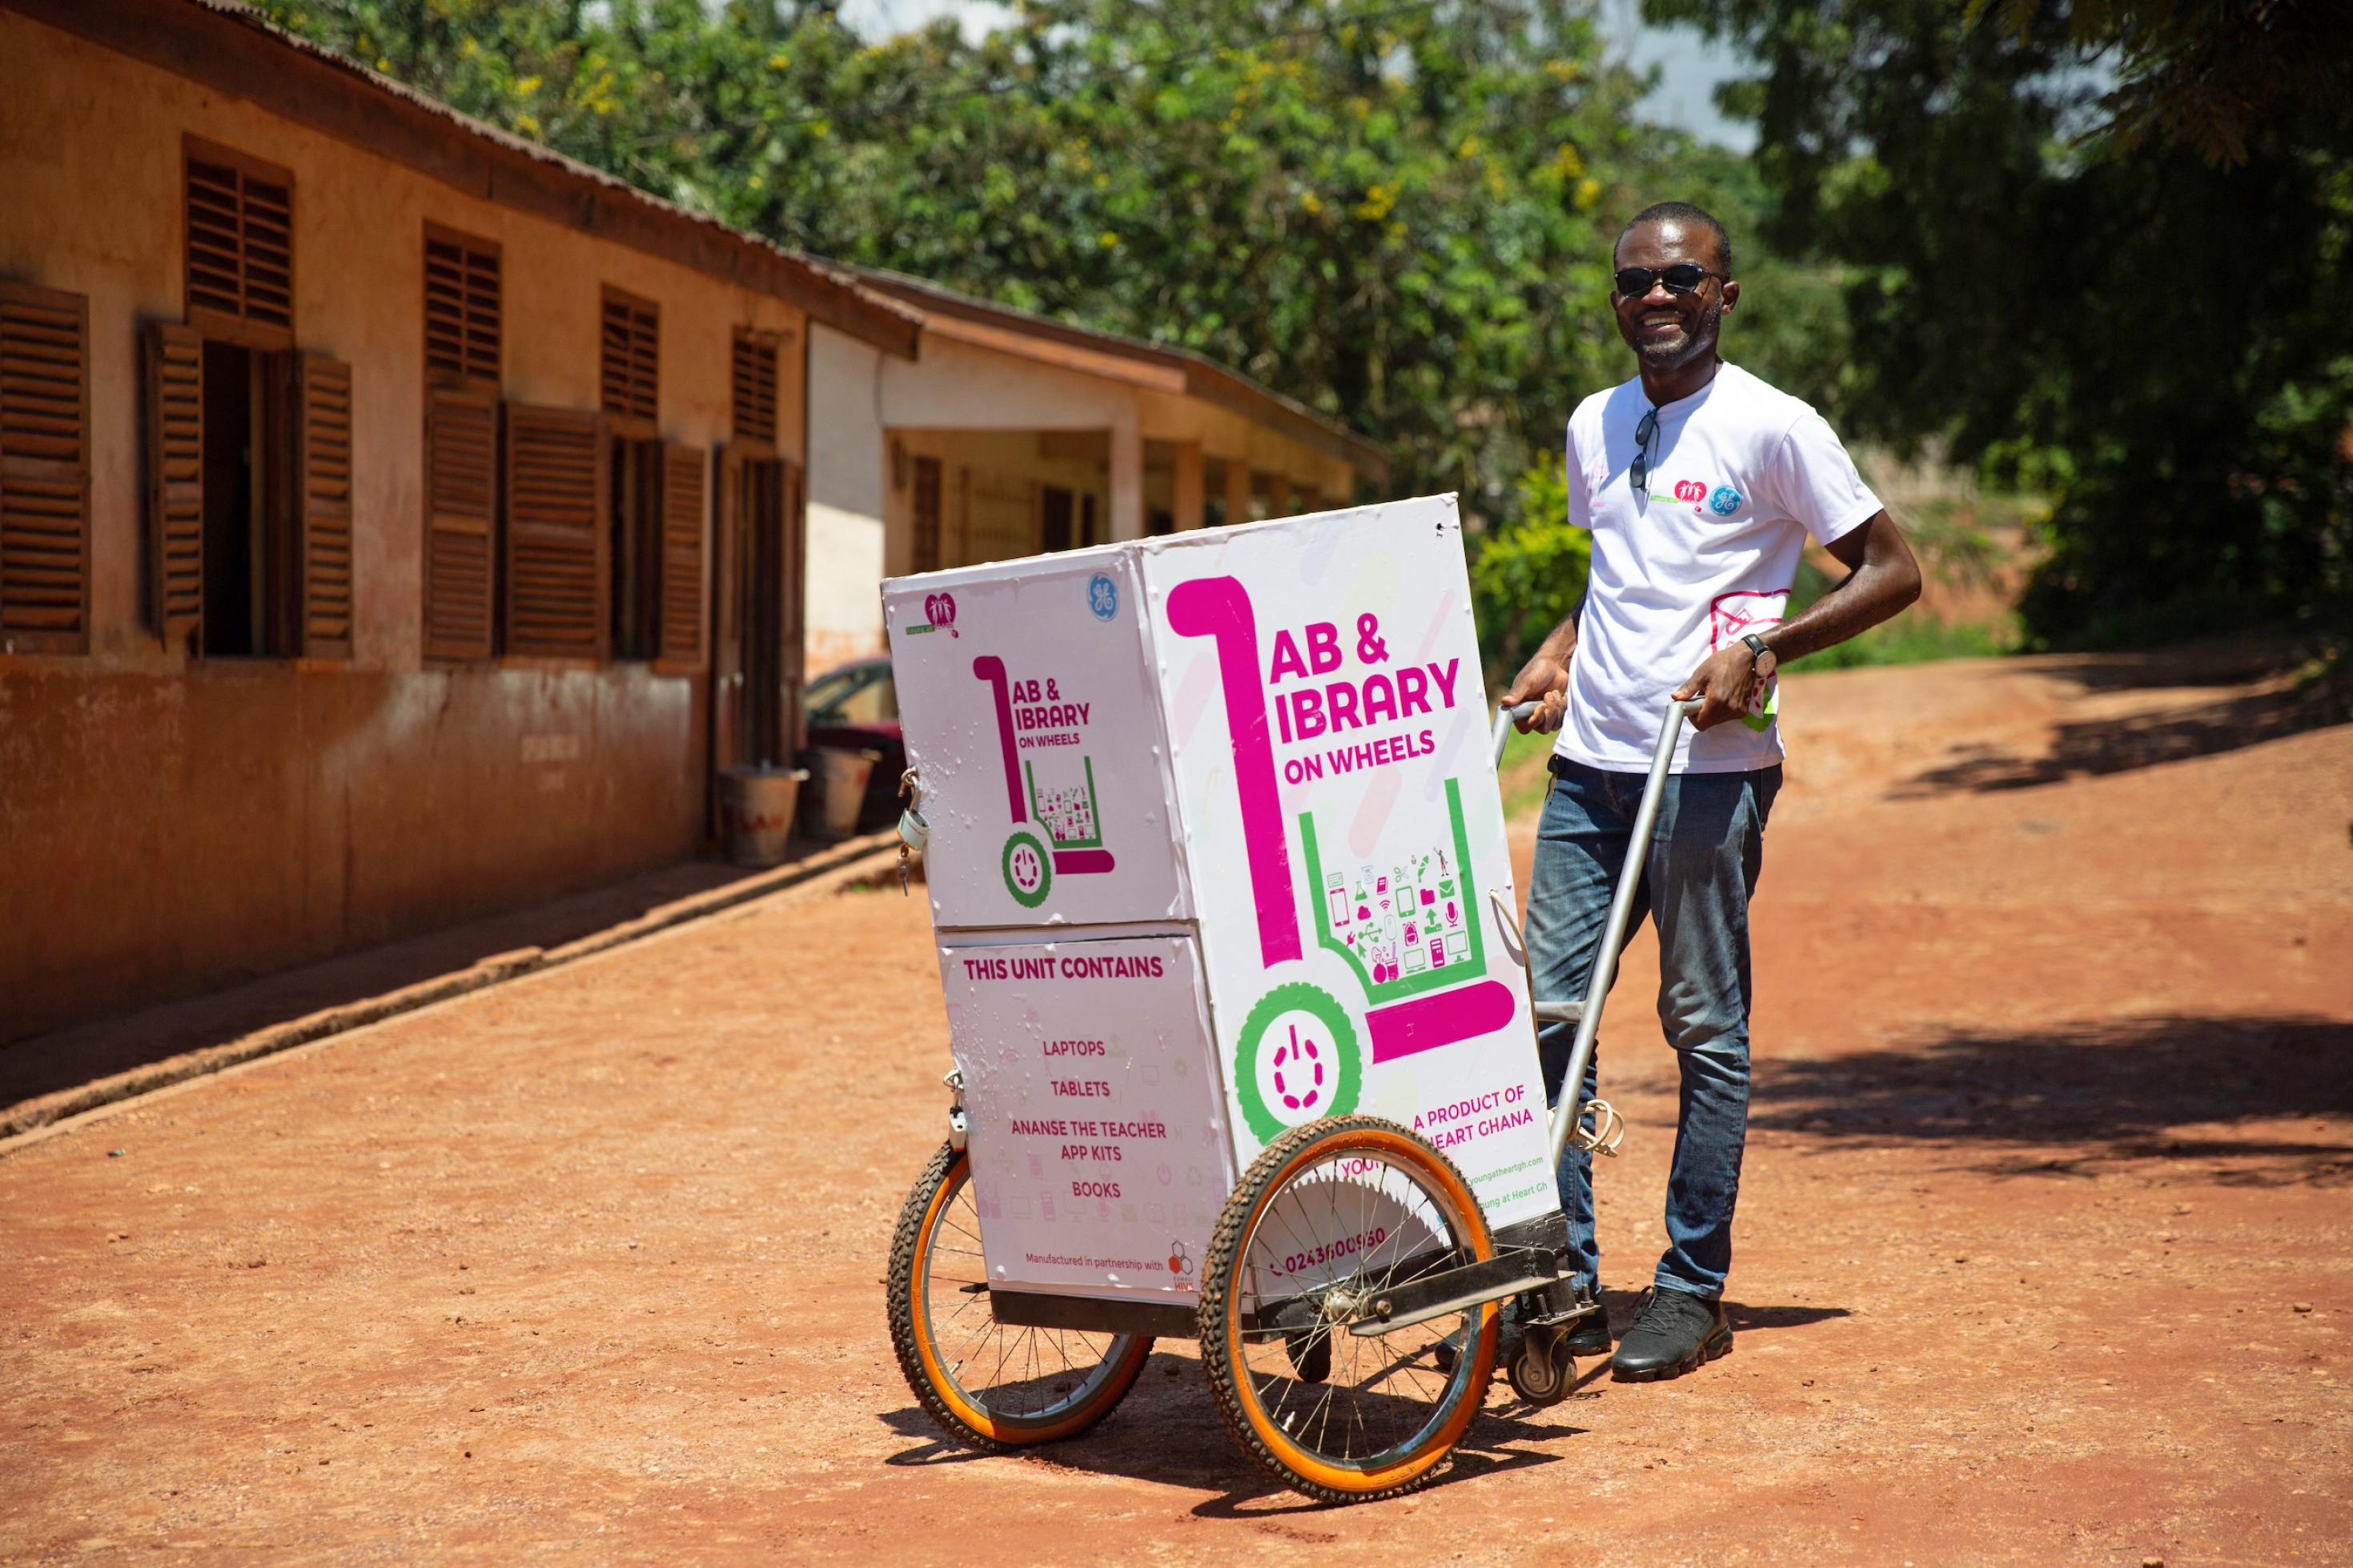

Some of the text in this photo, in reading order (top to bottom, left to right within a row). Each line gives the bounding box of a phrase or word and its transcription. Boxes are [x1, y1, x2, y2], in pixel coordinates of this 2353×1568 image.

[1270, 612, 1390, 685] AB &
[1012, 678, 1060, 704] AB &
[1274, 658, 1460, 745] IBRARY
[1015, 703, 1090, 731] IBRARY
[1018, 732, 1081, 749] ON WHEELS
[1284, 729, 1435, 786] ON WHEELS
[963, 956, 1164, 981] THIS UNIT CONTAINS
[1043, 1041, 1106, 1057] LAPTOPS
[1050, 1081, 1110, 1097] TABLETS
[1413, 1085, 1524, 1131] A PRODUCT OF
[1011, 1120, 1166, 1139] ANANSE THE TEACHER
[1478, 1109, 1533, 1137] GHANA
[1061, 1145, 1122, 1161] APP KITS
[1072, 1182, 1121, 1198] BOOKS
[1502, 1193, 1511, 1203] at
[1512, 1186, 1536, 1200] Heart
[1536, 1181, 1548, 1192] Gh
[1026, 1253, 1163, 1271] Manufactured in partnership with
